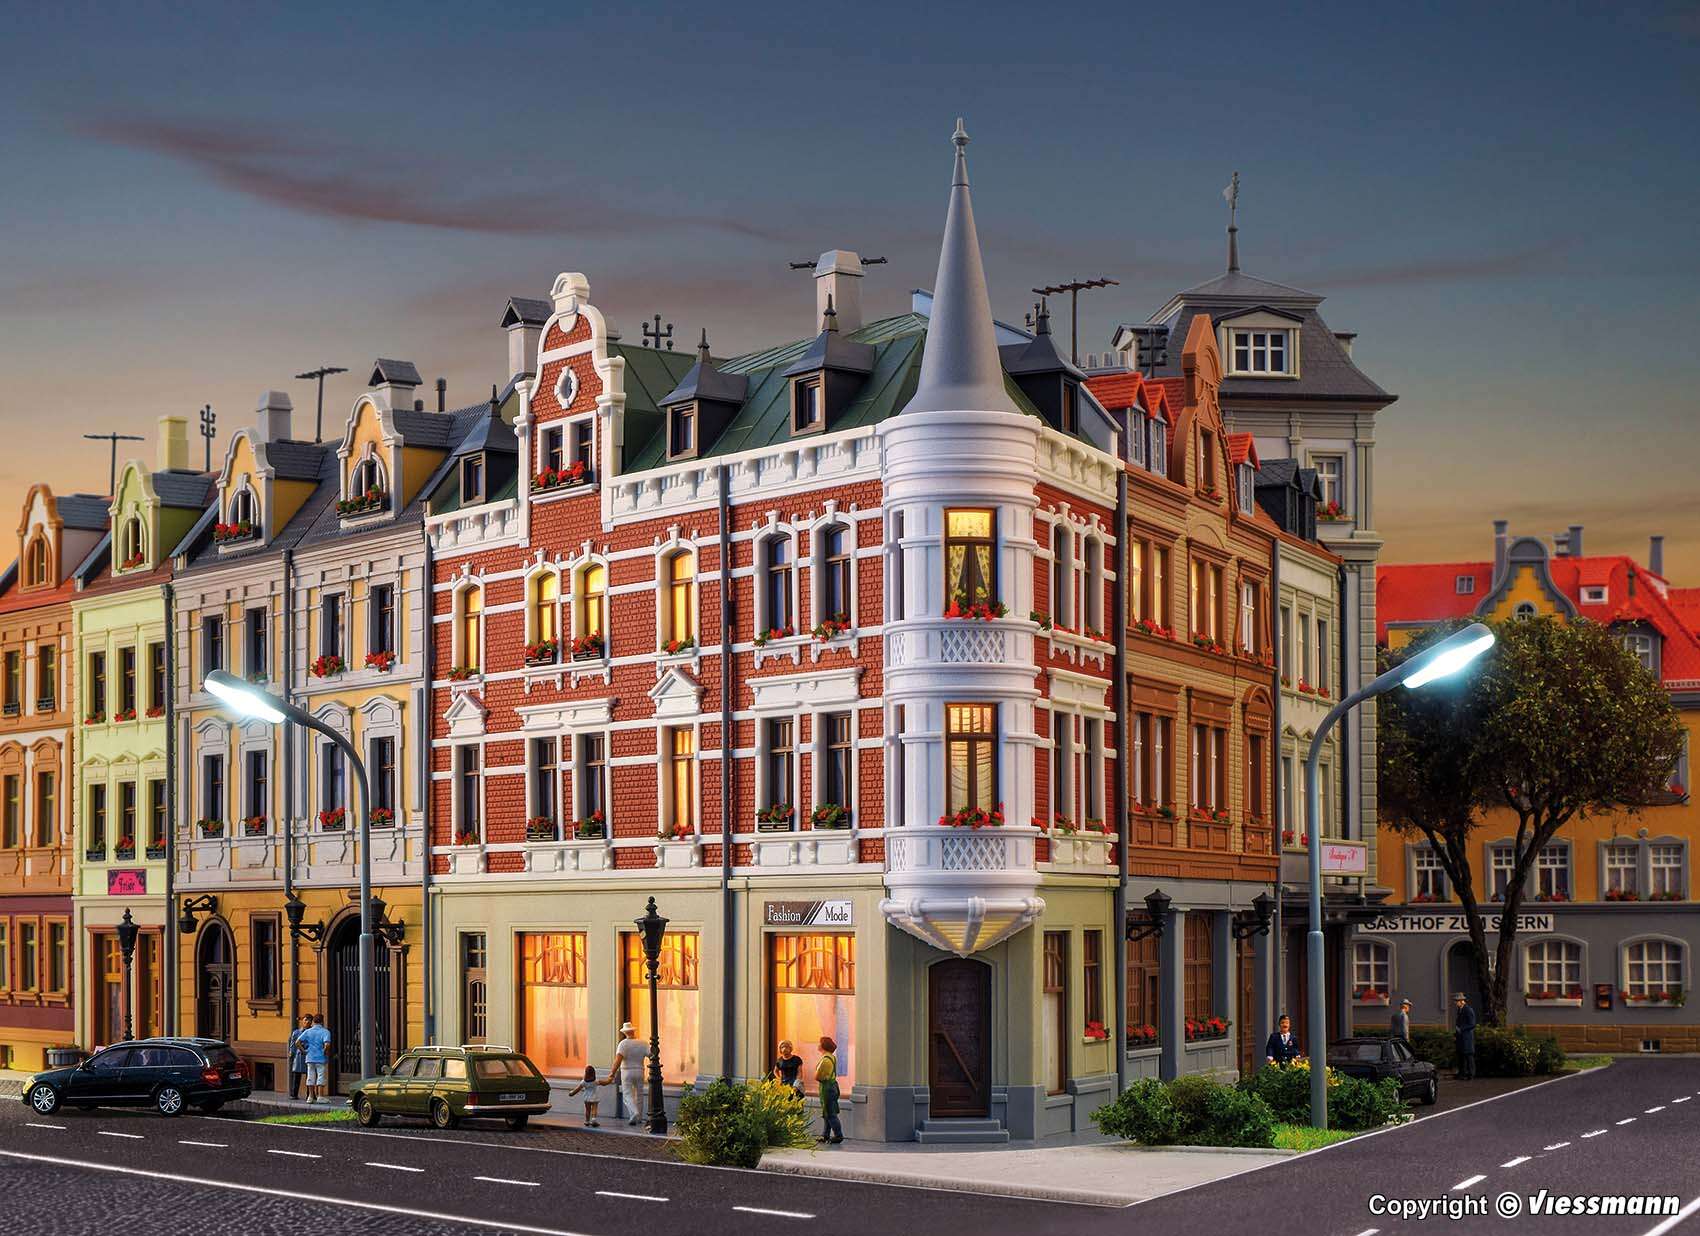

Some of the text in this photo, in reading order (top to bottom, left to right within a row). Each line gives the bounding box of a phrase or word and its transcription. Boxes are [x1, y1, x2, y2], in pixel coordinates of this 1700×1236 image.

[768, 904, 849, 921] Fashion Mode
[1449, 916, 1486, 930] ZU
[1491, 916, 1549, 930] SERN
